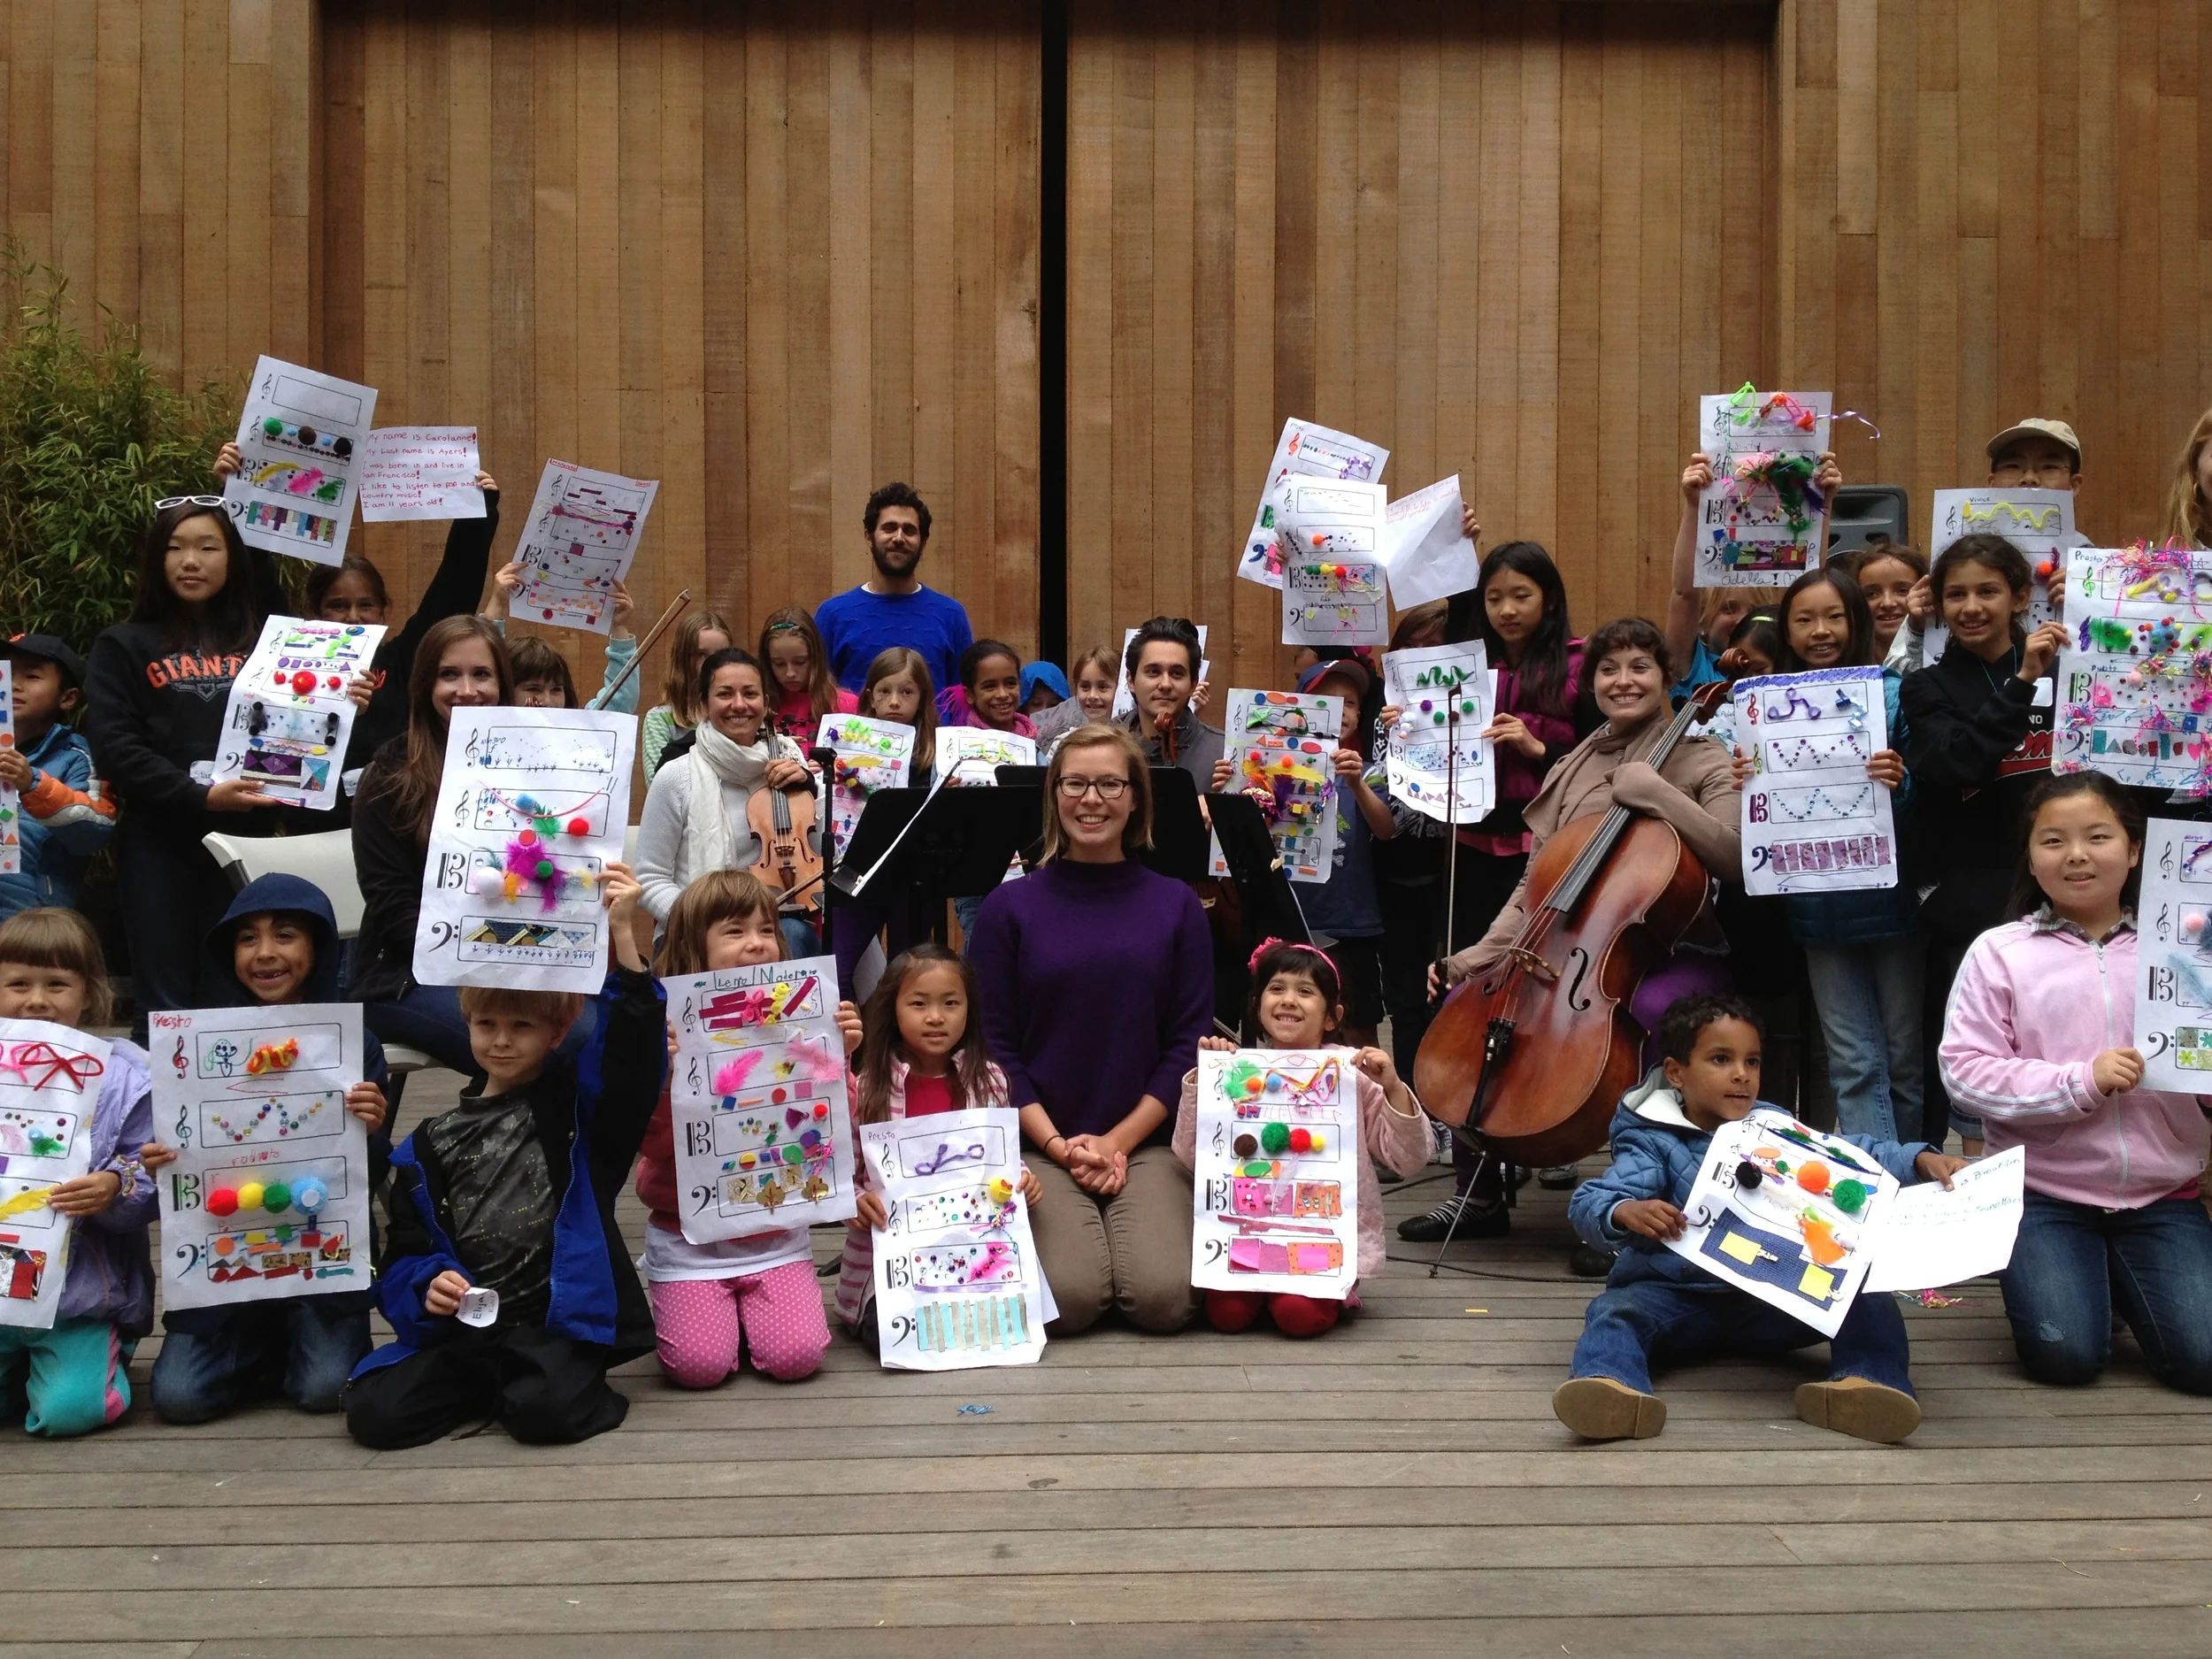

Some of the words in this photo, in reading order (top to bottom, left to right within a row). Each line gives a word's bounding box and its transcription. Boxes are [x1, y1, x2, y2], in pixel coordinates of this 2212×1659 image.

[426, 433, 477, 444] Carolanne!
[439, 447, 467, 457] Ayers!
[377, 470, 420, 480] Francisco!
[426, 497, 442, 506] old!
[2075, 550, 2102, 564] Presto
[146, 653, 248, 688] GIANT
[868, 1131, 895, 1141] Presto
